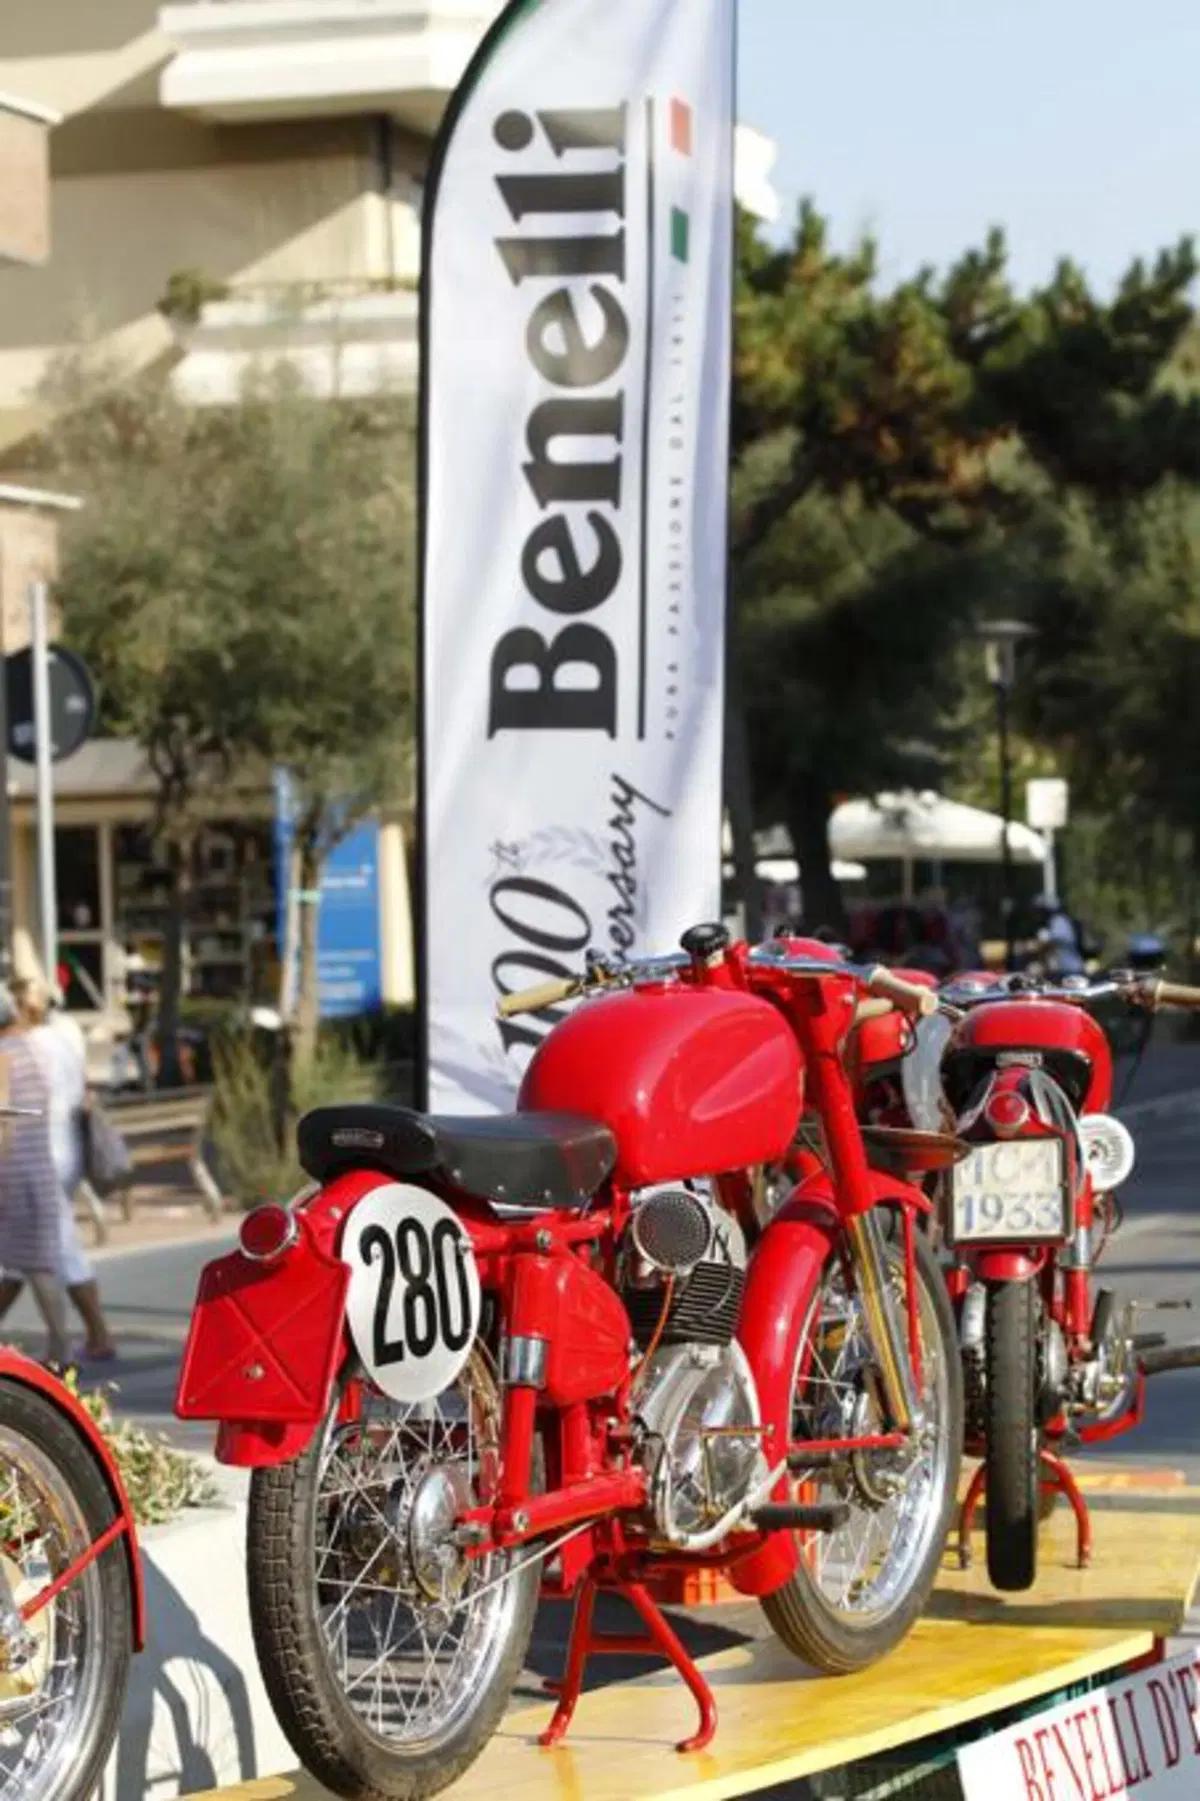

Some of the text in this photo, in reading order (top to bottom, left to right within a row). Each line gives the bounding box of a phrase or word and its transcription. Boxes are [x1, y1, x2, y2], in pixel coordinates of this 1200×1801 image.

[487, 98, 630, 740] Benelli
[667, 476, 683, 635] PASSIONE
[957, 1191, 1062, 1234] 1933
[359, 1216, 472, 1367] 280
[1014, 1690, 1152, 1801] BENELLI
